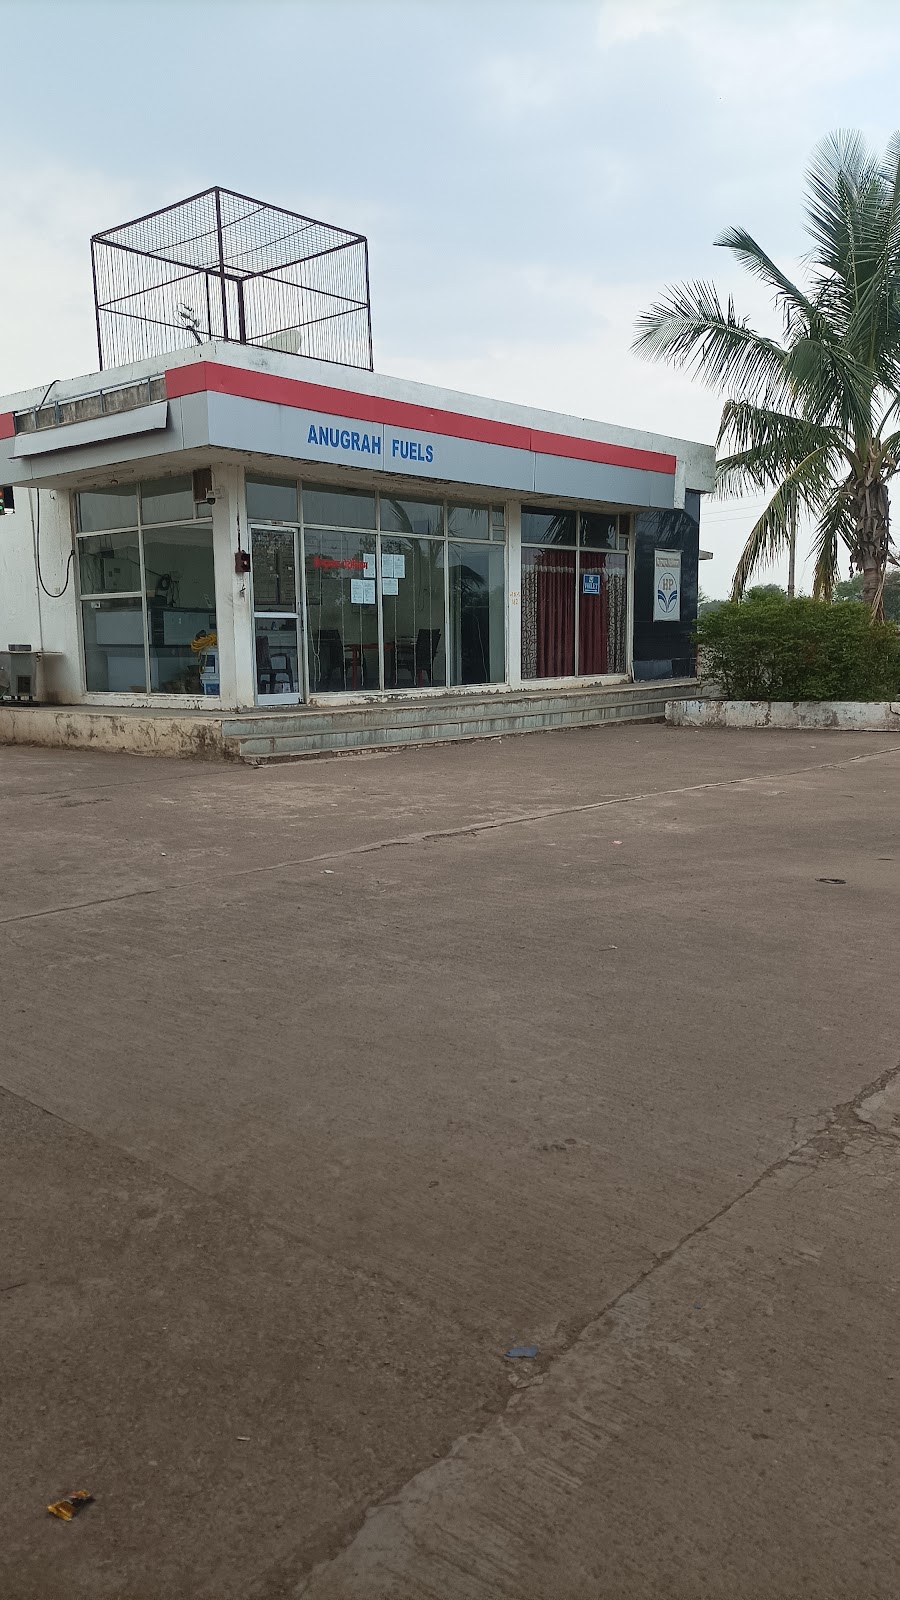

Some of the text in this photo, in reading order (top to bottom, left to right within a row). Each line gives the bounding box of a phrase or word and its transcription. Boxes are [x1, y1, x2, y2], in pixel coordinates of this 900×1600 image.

[307, 424, 434, 463] ANUGRAH FUELS
[662, 578, 674, 590] HP
